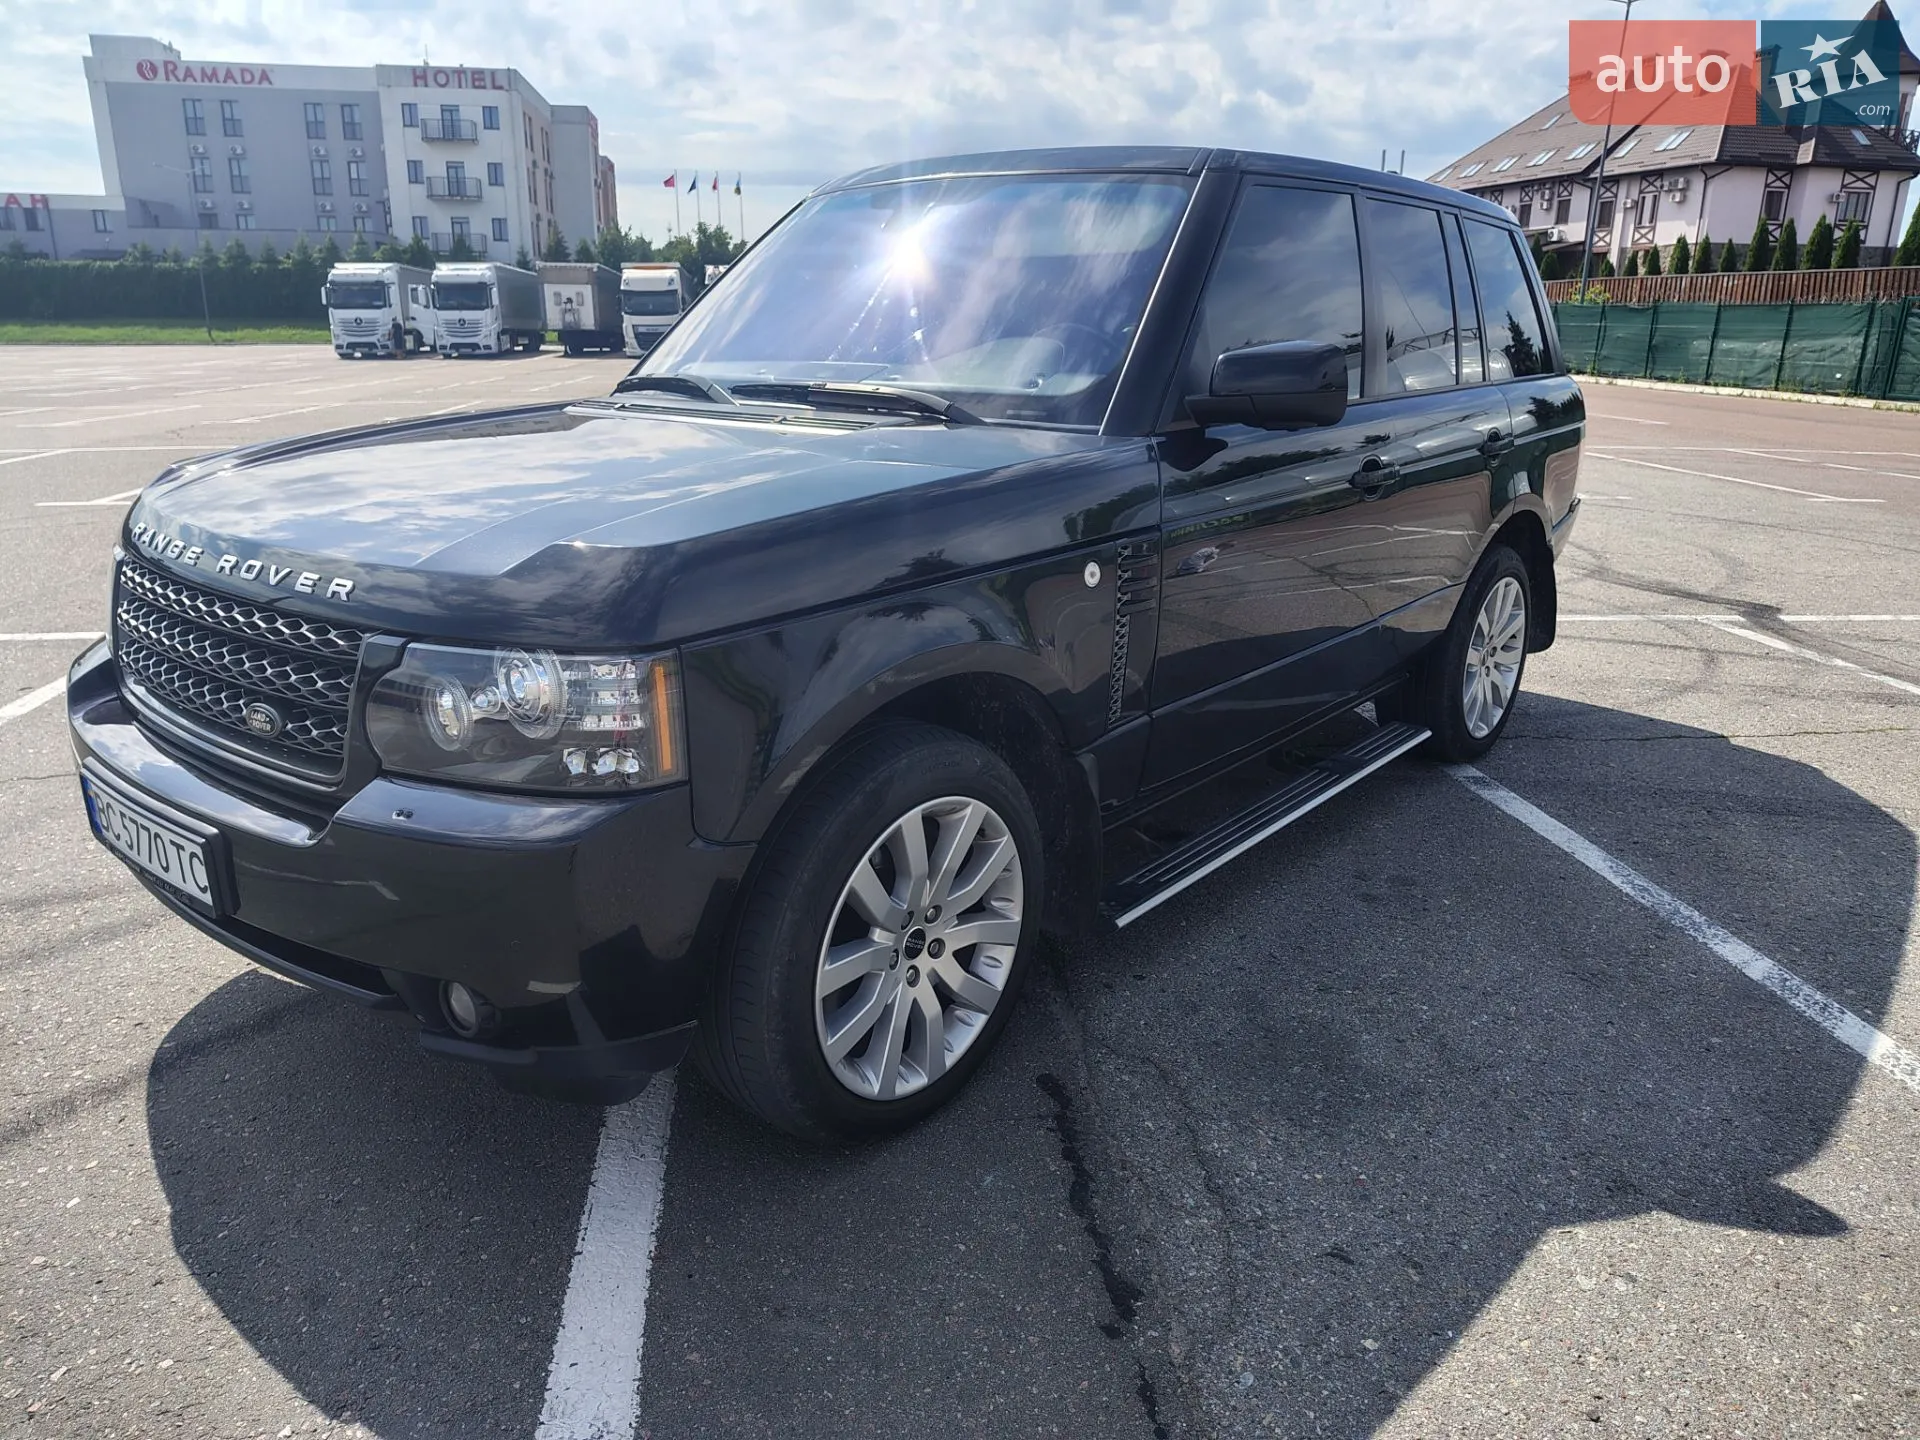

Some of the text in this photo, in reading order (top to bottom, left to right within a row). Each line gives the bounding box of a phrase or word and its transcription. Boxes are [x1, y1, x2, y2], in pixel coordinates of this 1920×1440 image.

[163, 60, 273, 86] RAMADA
[412, 68, 505, 91] HOTEL
[131, 522, 355, 601] RANGE ROVER
[119, 809, 170, 874] 5770
[168, 838, 209, 895] TC
